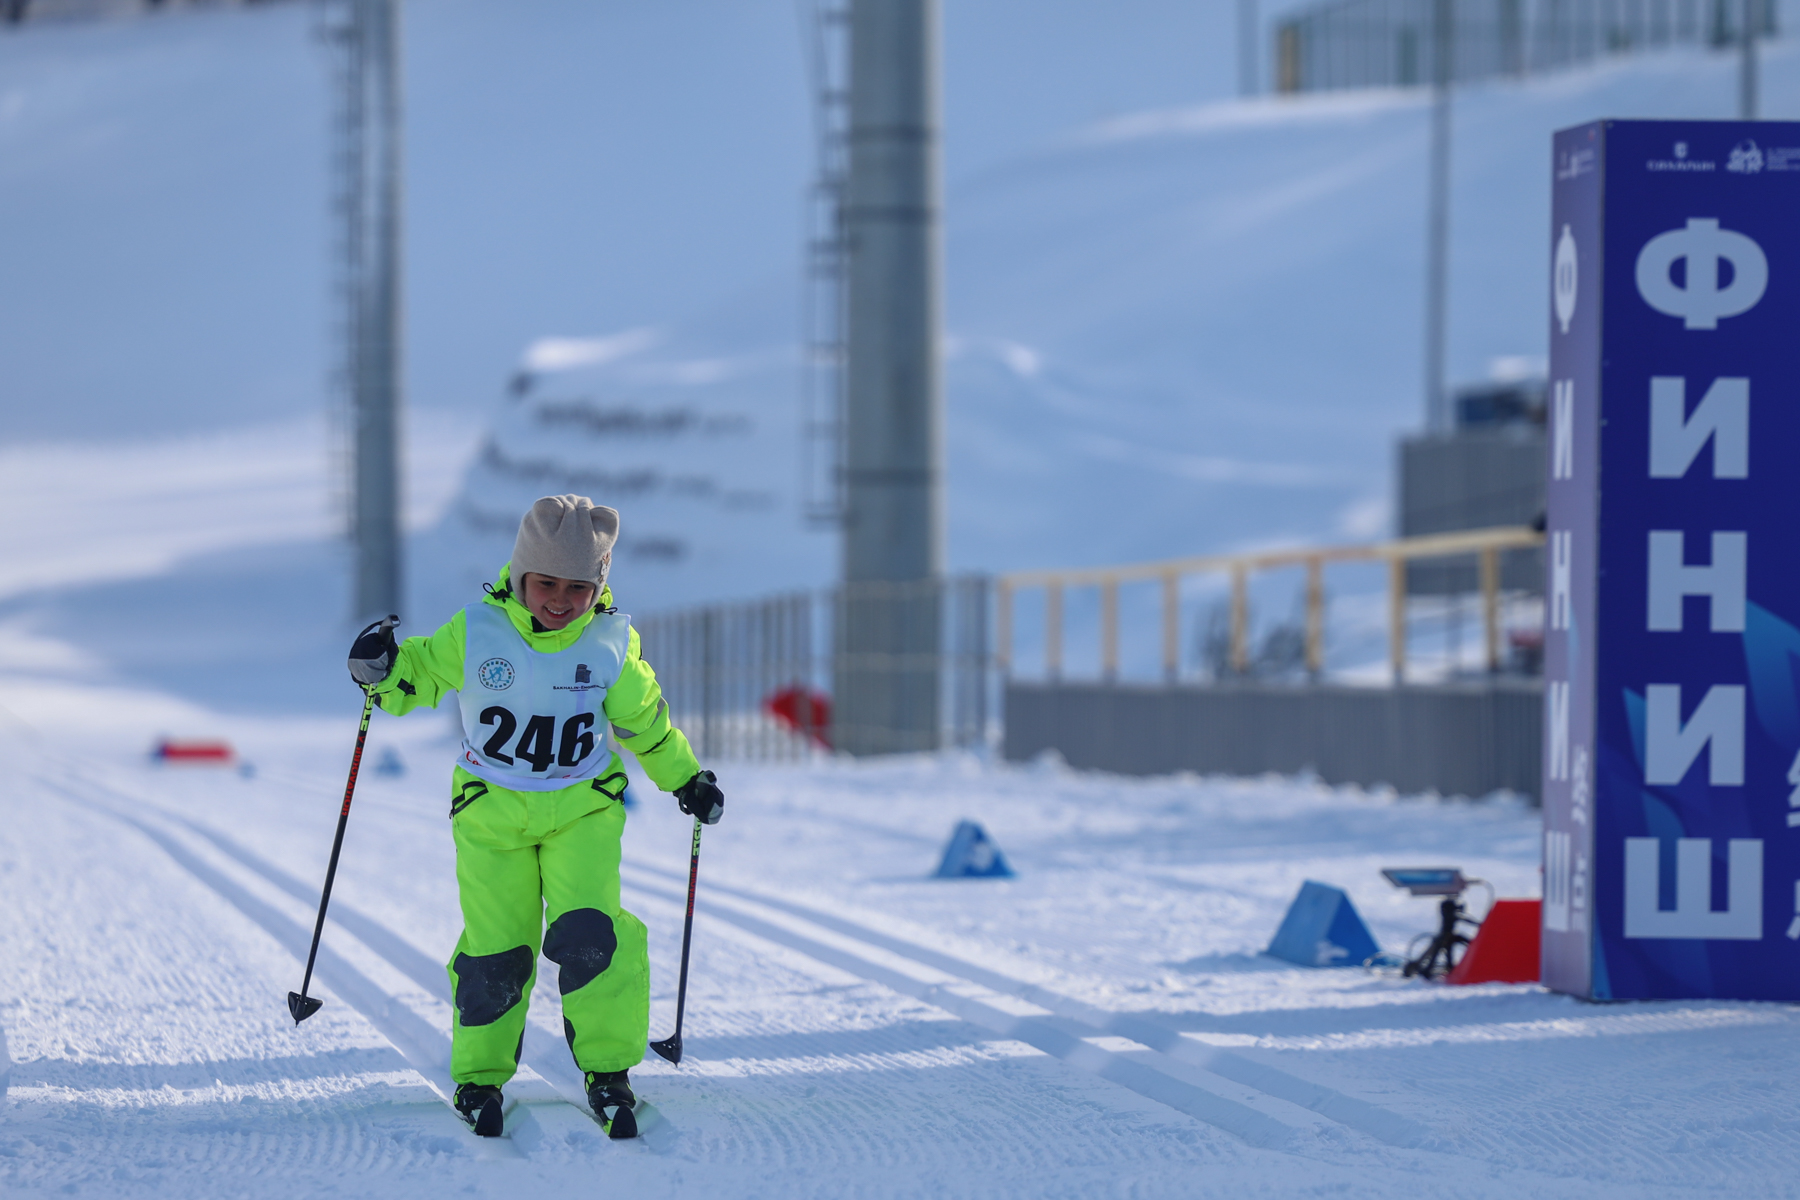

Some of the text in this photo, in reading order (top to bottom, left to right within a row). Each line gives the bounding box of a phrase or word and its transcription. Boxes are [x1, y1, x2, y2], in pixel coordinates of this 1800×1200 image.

[480, 706, 595, 772] 246
[1546, 223, 1578, 932] ФИНИШ
[1624, 217, 1768, 940] ФИНИШ
